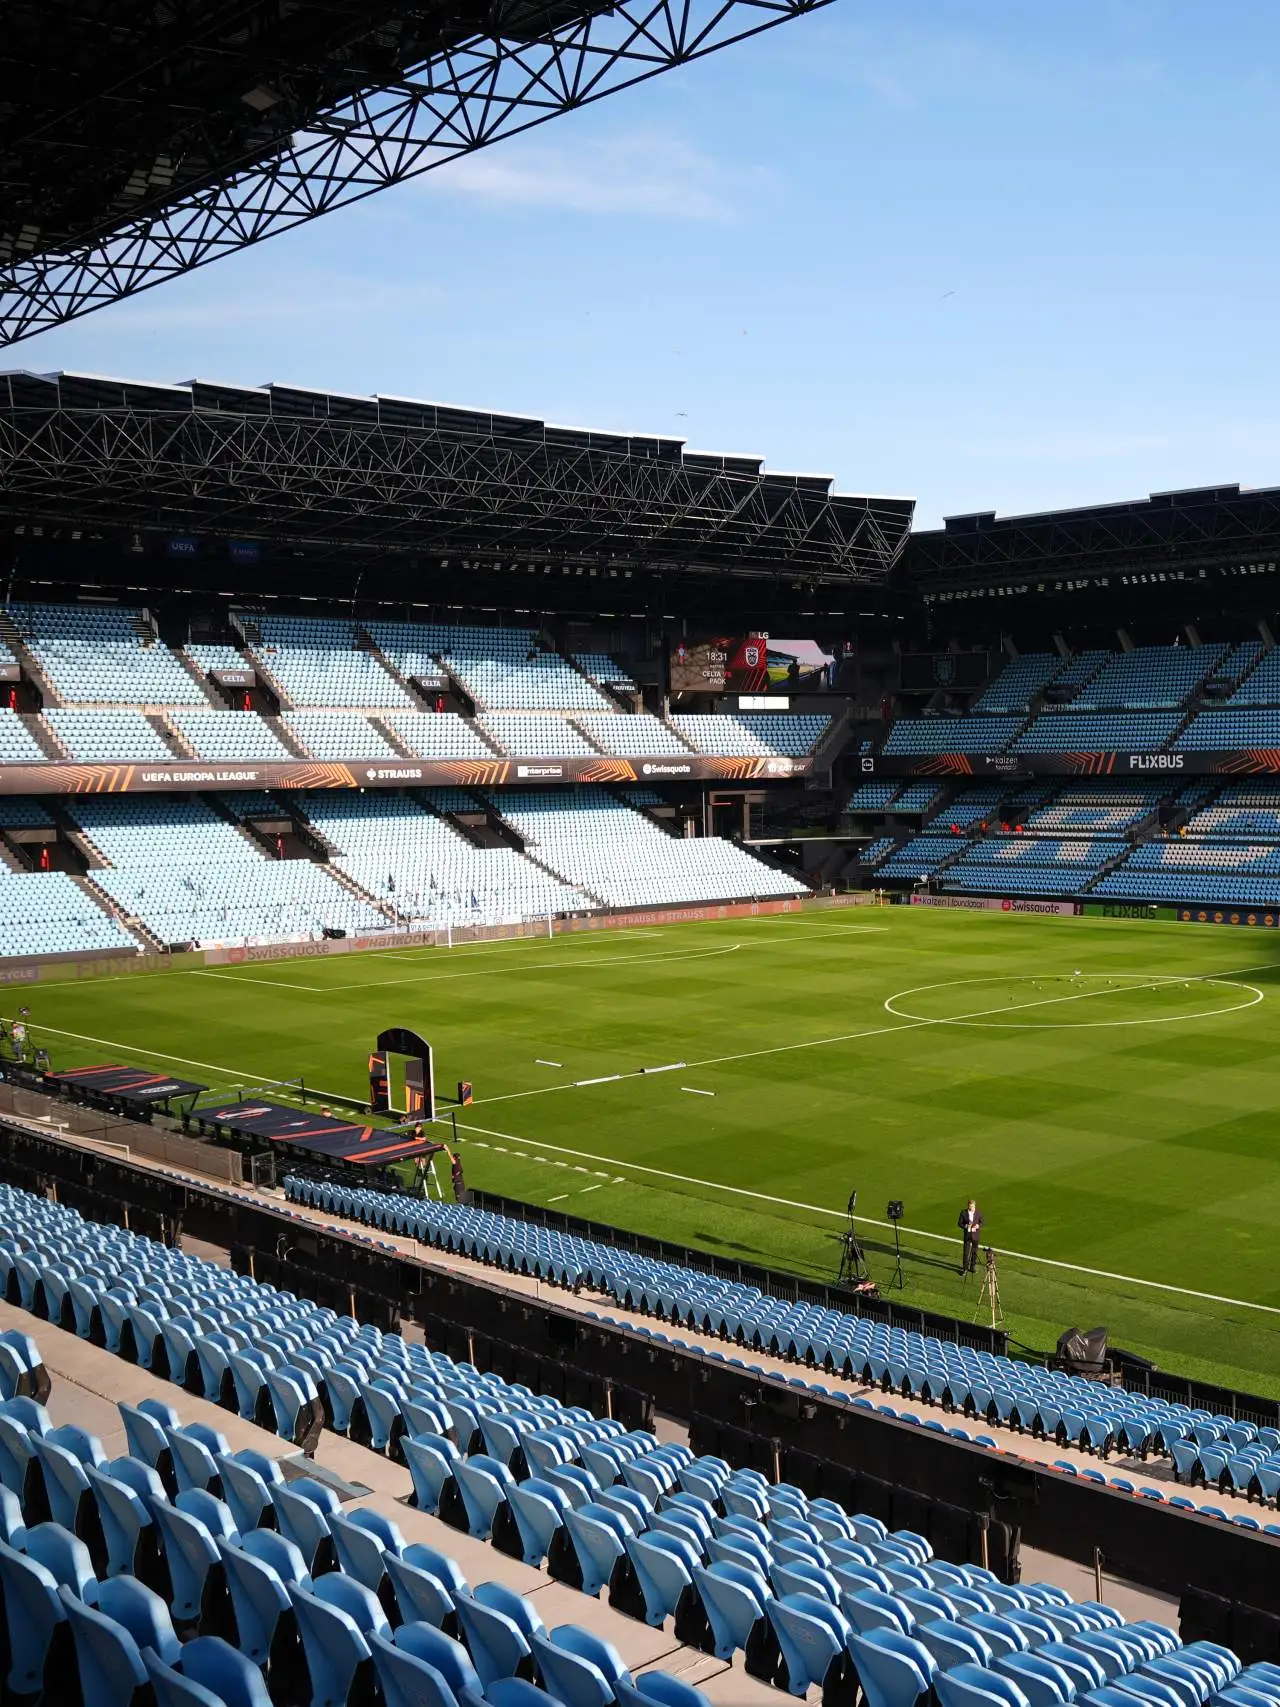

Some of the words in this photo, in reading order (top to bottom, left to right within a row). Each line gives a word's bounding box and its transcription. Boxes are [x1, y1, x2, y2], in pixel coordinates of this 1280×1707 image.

[757, 631, 769, 640] LG
[222, 674, 246, 683] CELTA
[702, 670, 721, 678] CELTA
[421, 679, 441, 688] CELTA
[378, 768, 422, 779] STRAUSS
[651, 764, 691, 776] Swissquote
[142, 772, 171, 782] UEFA
[173, 772, 215, 782] EUROPA
[217, 771, 256, 781] LEAGUE
[1011, 900, 1060, 915] Swissquote
[617, 914, 657, 926] STRAUSS
[666, 910, 705, 921] STRAUSS
[247, 940, 330, 961] Swissquote
